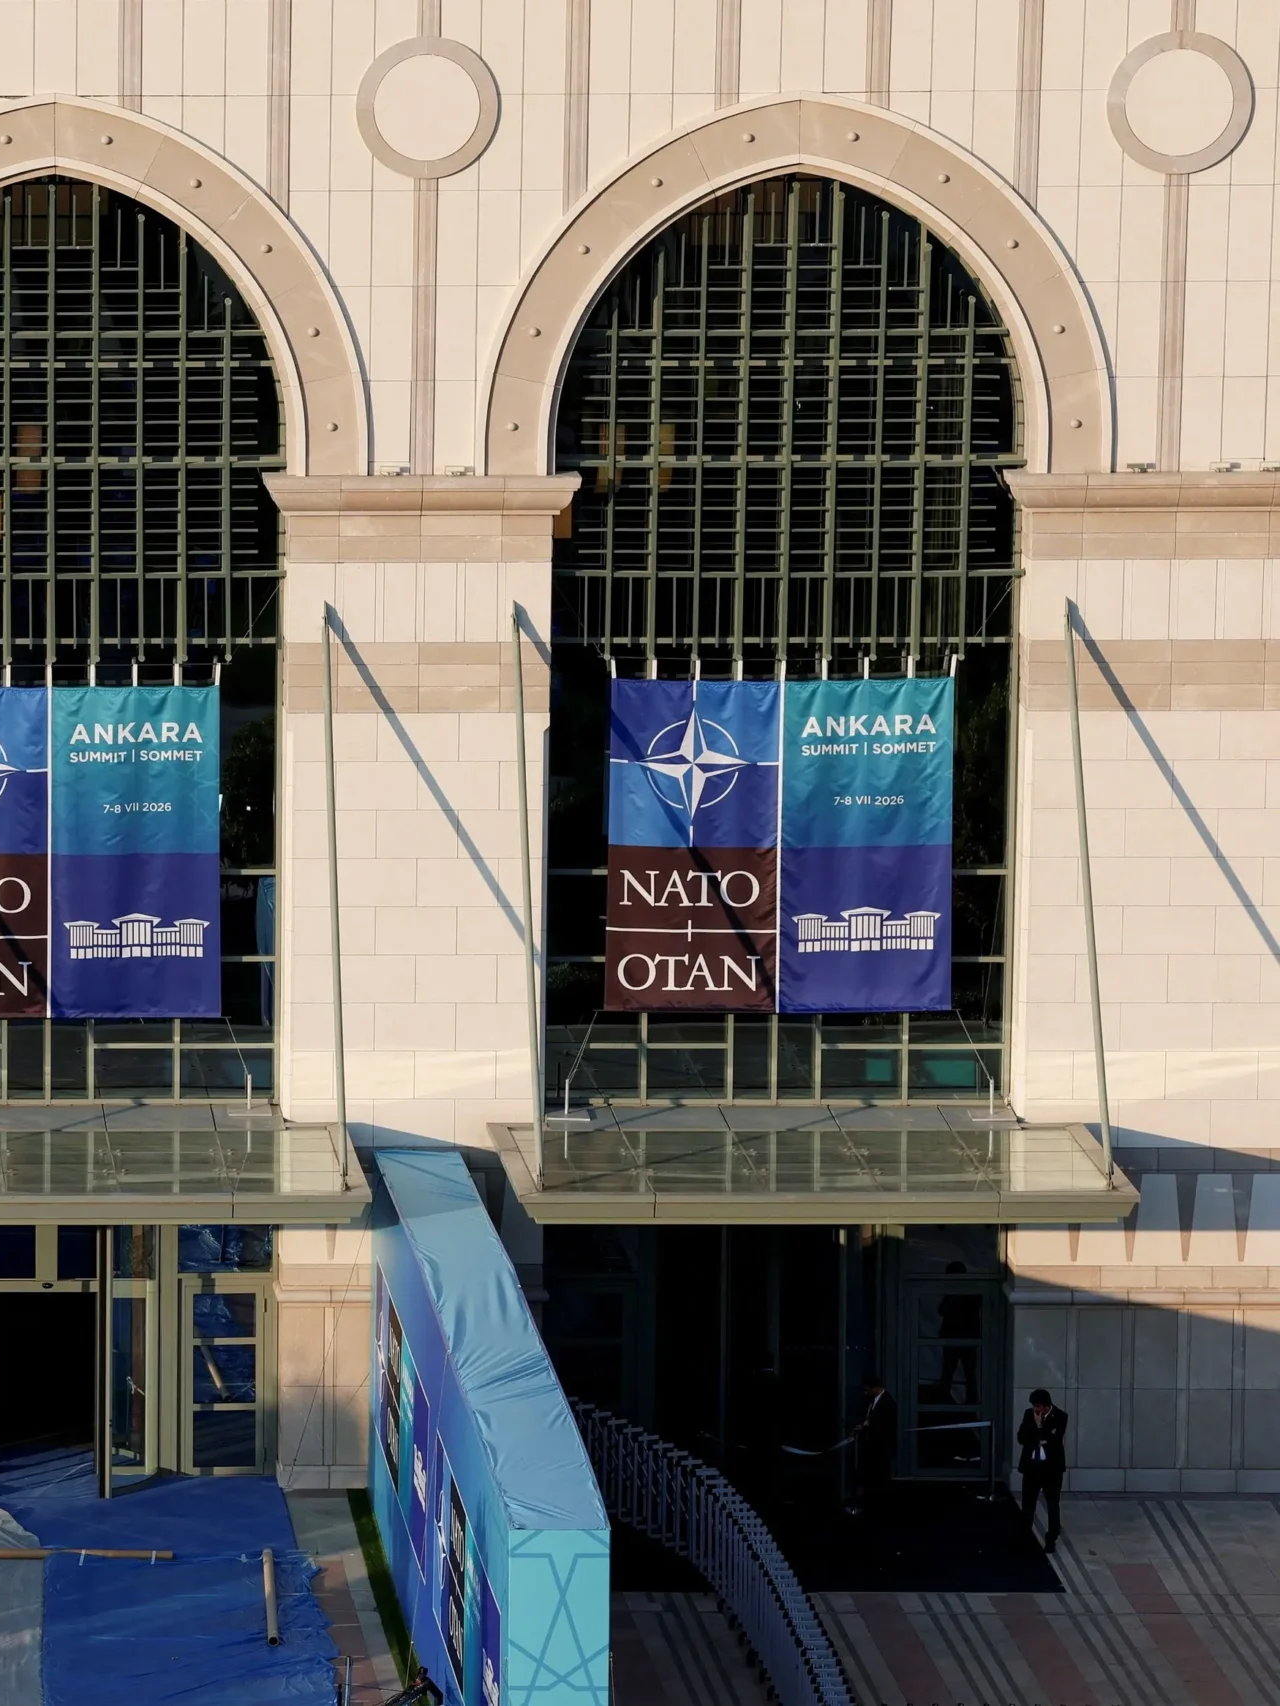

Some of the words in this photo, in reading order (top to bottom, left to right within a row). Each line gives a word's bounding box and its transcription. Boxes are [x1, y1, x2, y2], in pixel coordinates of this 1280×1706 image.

[69, 721, 204, 745] ANKARA
[801, 713, 937, 738] ANKARA
[69, 750, 128, 763] SUMMIT
[140, 749, 204, 762] SOMMET
[801, 744, 860, 756] SUMMIT
[872, 741, 937, 755] SOMMET
[103, 804, 122, 814] 7-8
[125, 802, 139, 812] VII
[142, 802, 172, 812] 2026
[834, 796, 852, 806] 7-8
[856, 795, 871, 805] VII
[874, 795, 905, 806] 2026
[619, 869, 760, 908] NATO
[617, 953, 761, 992] OTAN
